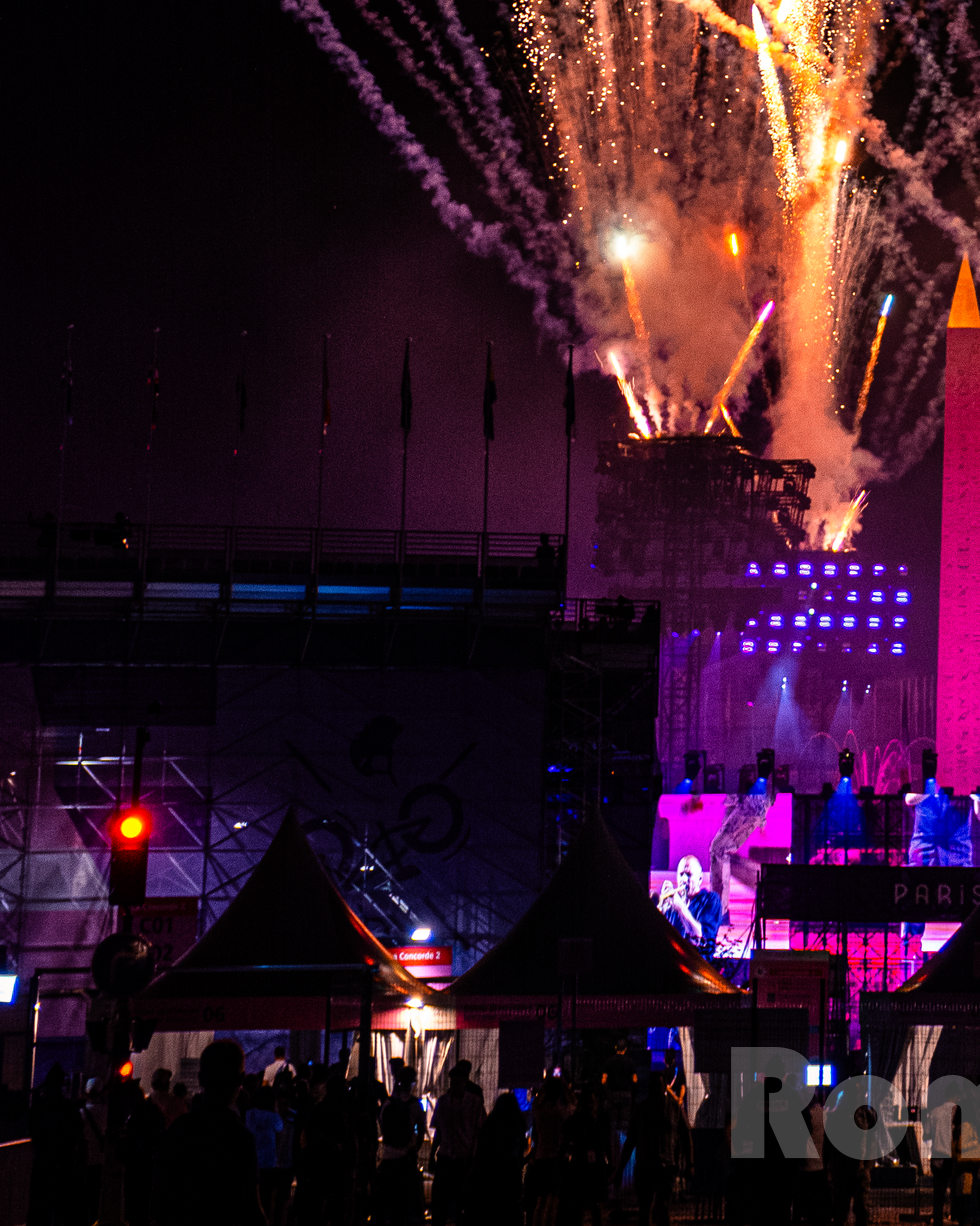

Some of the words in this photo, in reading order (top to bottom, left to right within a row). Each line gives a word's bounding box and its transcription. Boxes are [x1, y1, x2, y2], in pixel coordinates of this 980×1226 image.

[140, 918, 173, 934] C01
[399, 951, 434, 961] Concorde
[436, 951, 441, 960] 2
[203, 1006, 225, 1022] 06
